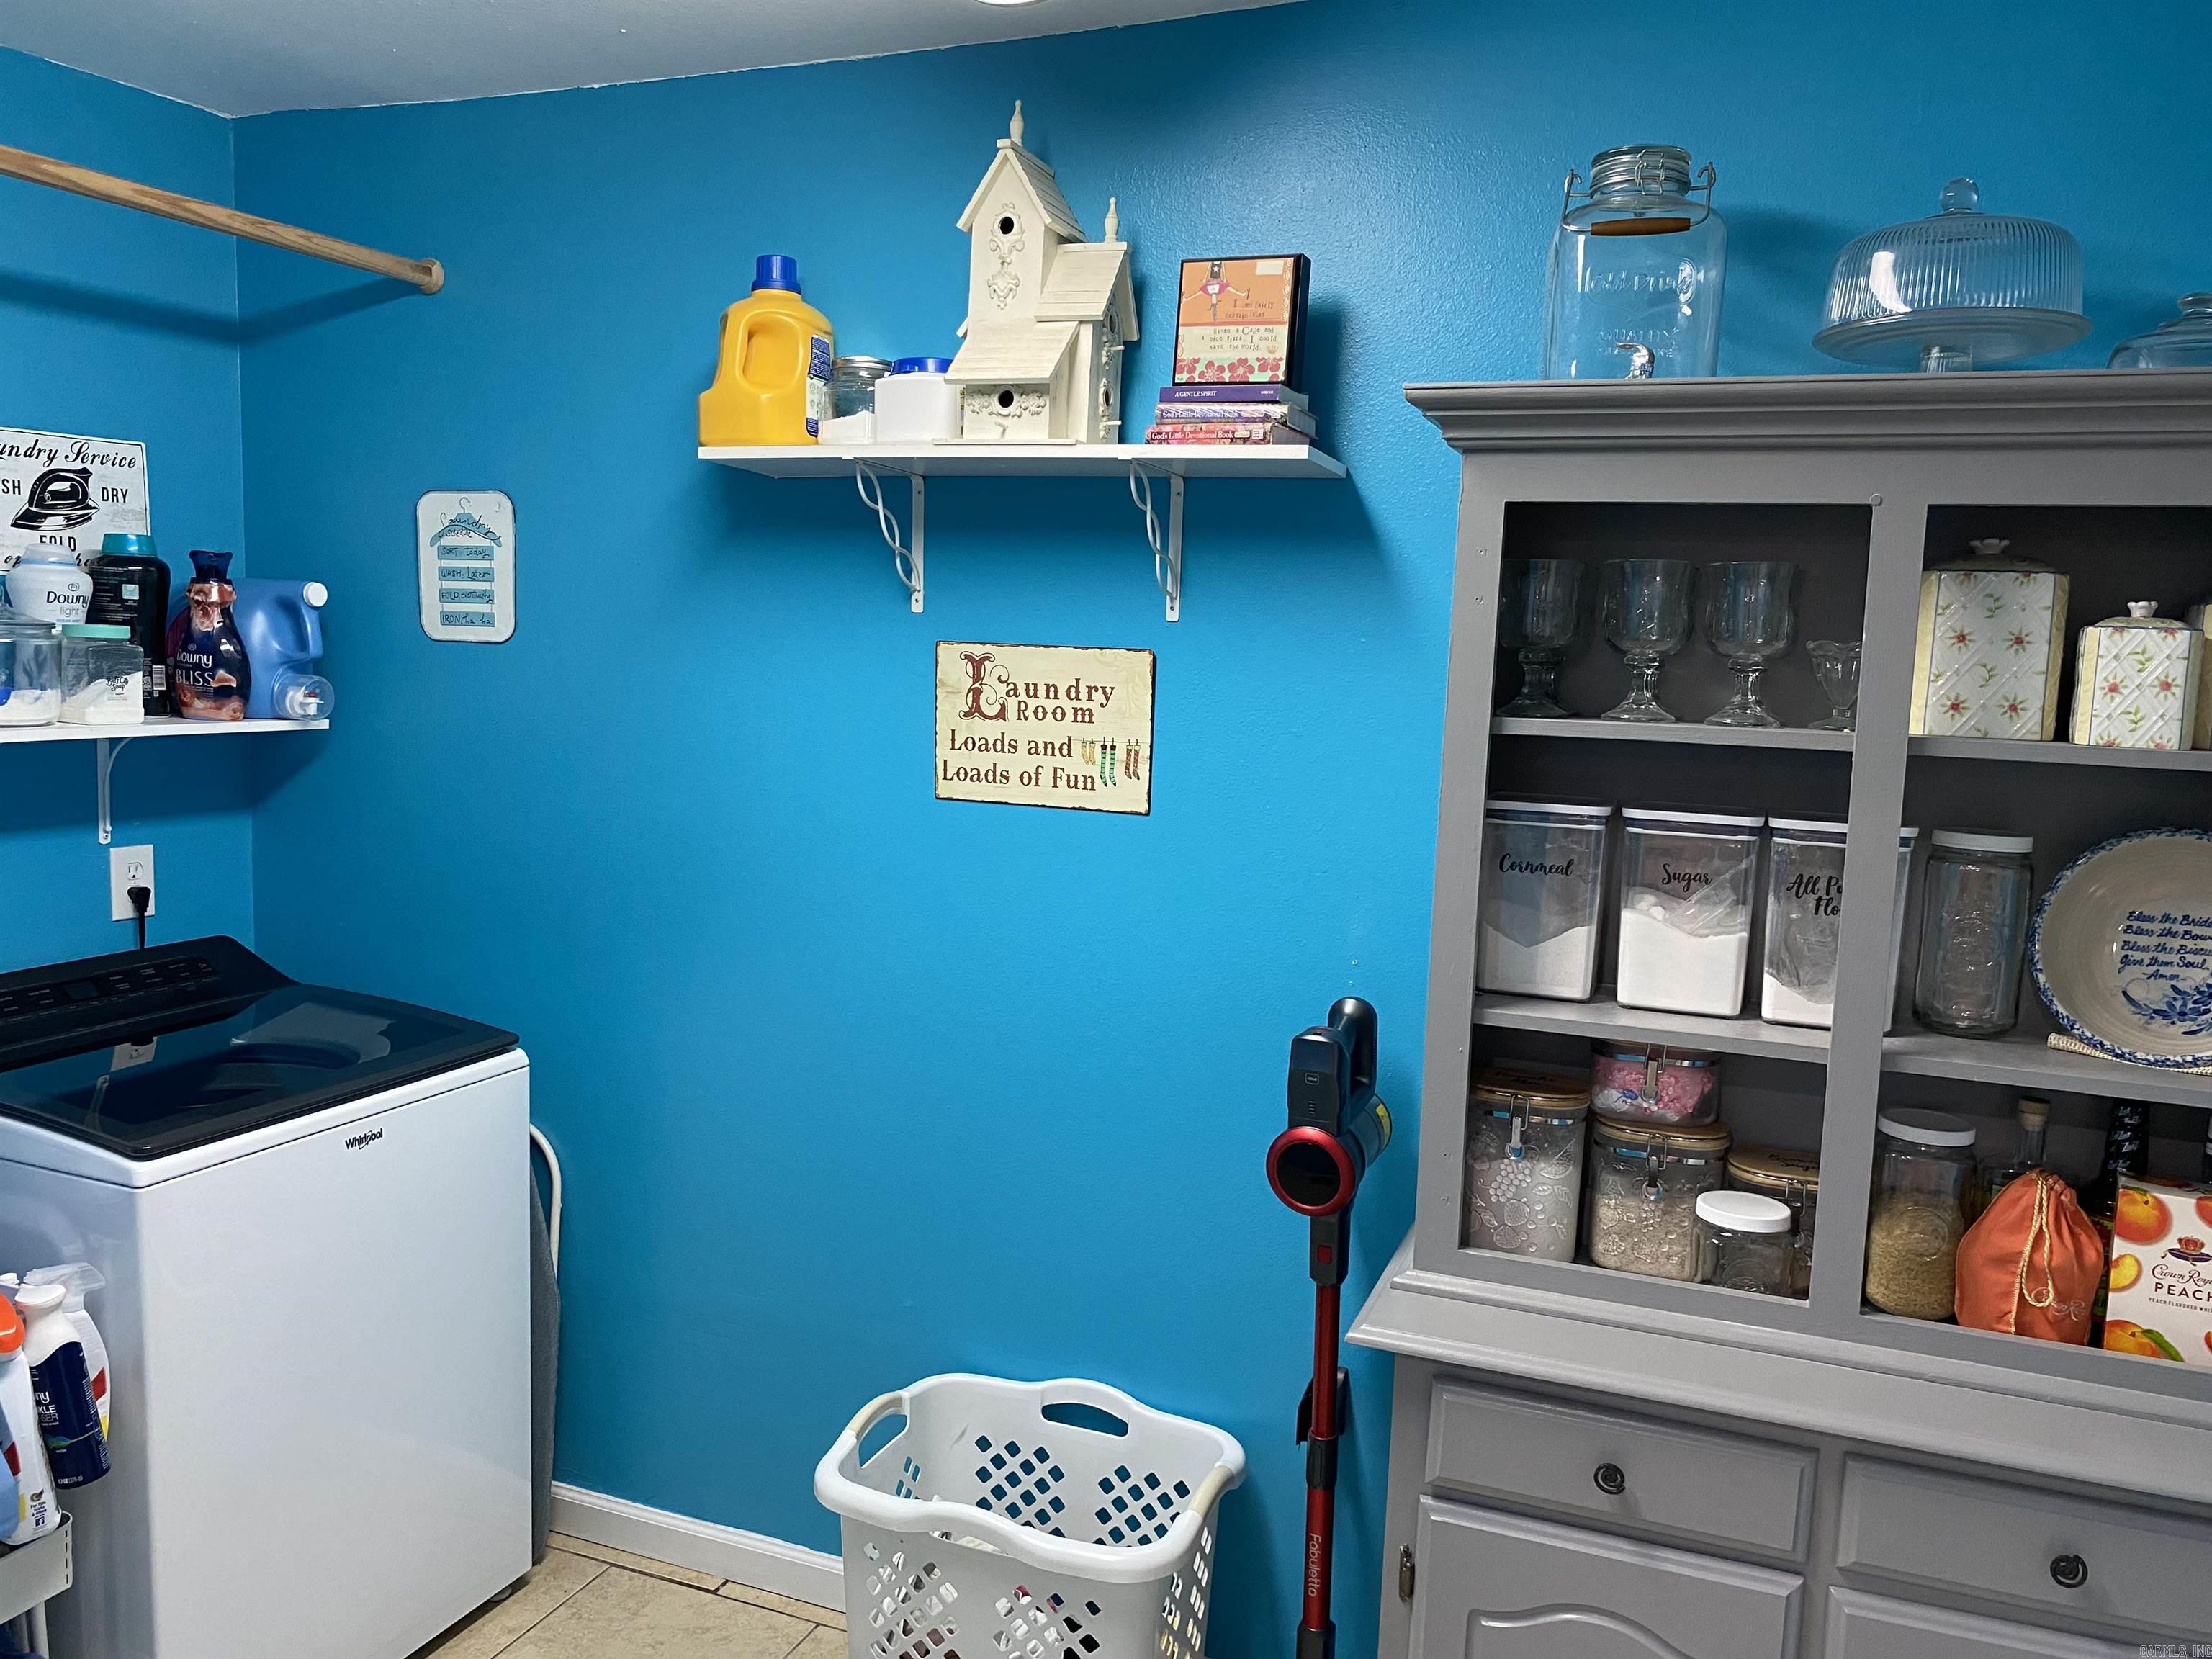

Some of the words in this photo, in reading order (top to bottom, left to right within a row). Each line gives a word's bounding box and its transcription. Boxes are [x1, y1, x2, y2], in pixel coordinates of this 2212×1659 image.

[1233, 298, 1238, 308] I
[1241, 326, 1261, 335] Cape
[1249, 335, 1254, 344] I
[0, 439, 59, 468] undry
[65, 441, 137, 469] Service
[1, 478, 22, 495] SH
[102, 486, 129, 504] DRY
[46, 590, 89, 608] Downy
[60, 606, 79, 619] light
[176, 649, 212, 669] Downy
[176, 668, 214, 687] BLISS
[958, 650, 1116, 723] Laundry
[949, 728, 1018, 755] Loads
[1027, 735, 1074, 758] and
[941, 759, 1010, 785] Loads
[1018, 765, 1044, 787] of
[1051, 766, 1097, 791] Fun
[1498, 853, 1575, 877] Cornmeal
[1661, 863, 1713, 893] Sugar
[1786, 873, 1821, 899] All
[1814, 895, 1841, 916] Flo
[2126, 910, 2158, 924] Bless
[2158, 912, 2179, 925] the
[2123, 925, 2155, 938] Bless
[2156, 927, 2181, 939] the
[2180, 930, 2212, 941] Bow
[2121, 940, 2152, 953] Bless
[2152, 942, 2175, 955] the
[2175, 943, 2212, 957] Biscu
[2118, 953, 2145, 974] Give
[2146, 956, 2175, 968] them
[345, 1128, 383, 1151] Whirlpool
[2152, 1264, 2186, 1280] Crown
[2177, 1269, 2212, 1288] Roya
[2148, 1297, 2167, 1305] PEACH
[2167, 1300, 2198, 1311] FLAVORED
[1308, 1532, 1322, 1597] Fabuletto
